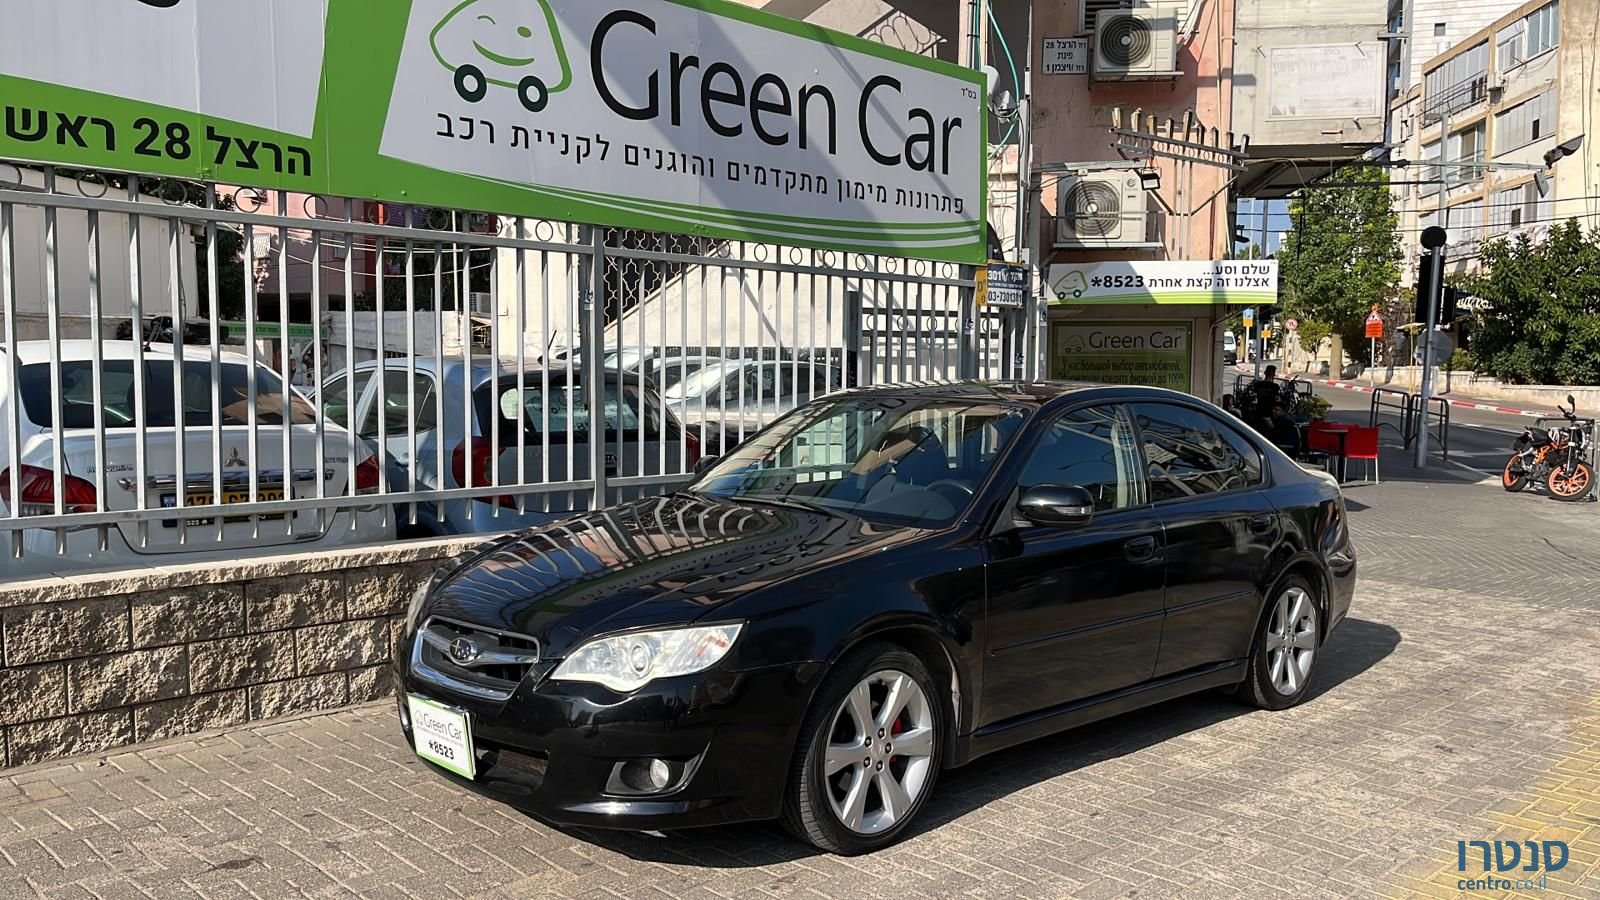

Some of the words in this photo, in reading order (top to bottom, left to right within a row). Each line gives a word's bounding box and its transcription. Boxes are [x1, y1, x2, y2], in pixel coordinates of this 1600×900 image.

[1056, 40, 1076, 48] הרצל
[1057, 52, 1073, 60] פינת
[1046, 64, 1050, 72] 1
[590, 9, 838, 155] Green
[858, 74, 963, 176] Car
[5, 105, 116, 152] ראש
[132, 117, 192, 160] 28
[436, 111, 495, 144] רכב
[206, 125, 312, 177] הרצל
[510, 124, 610, 165] לקניית
[624, 143, 715, 178] והוגנים
[727, 160, 828, 195] מתקדמים
[837, 177, 888, 204] מימון
[895, 187, 965, 215] פתרונות
[1148, 277, 1182, 288] אחרת
[1216, 277, 1230, 287] זה
[1234, 276, 1270, 287] אצלנו
[1242, 263, 1270, 275] שלם
[1186, 278, 1212, 290] קצת
[1088, 331, 1144, 349] Green
[1149, 331, 1182, 349] Car
[423, 713, 448, 736] Green
[447, 722, 463, 741] Car
